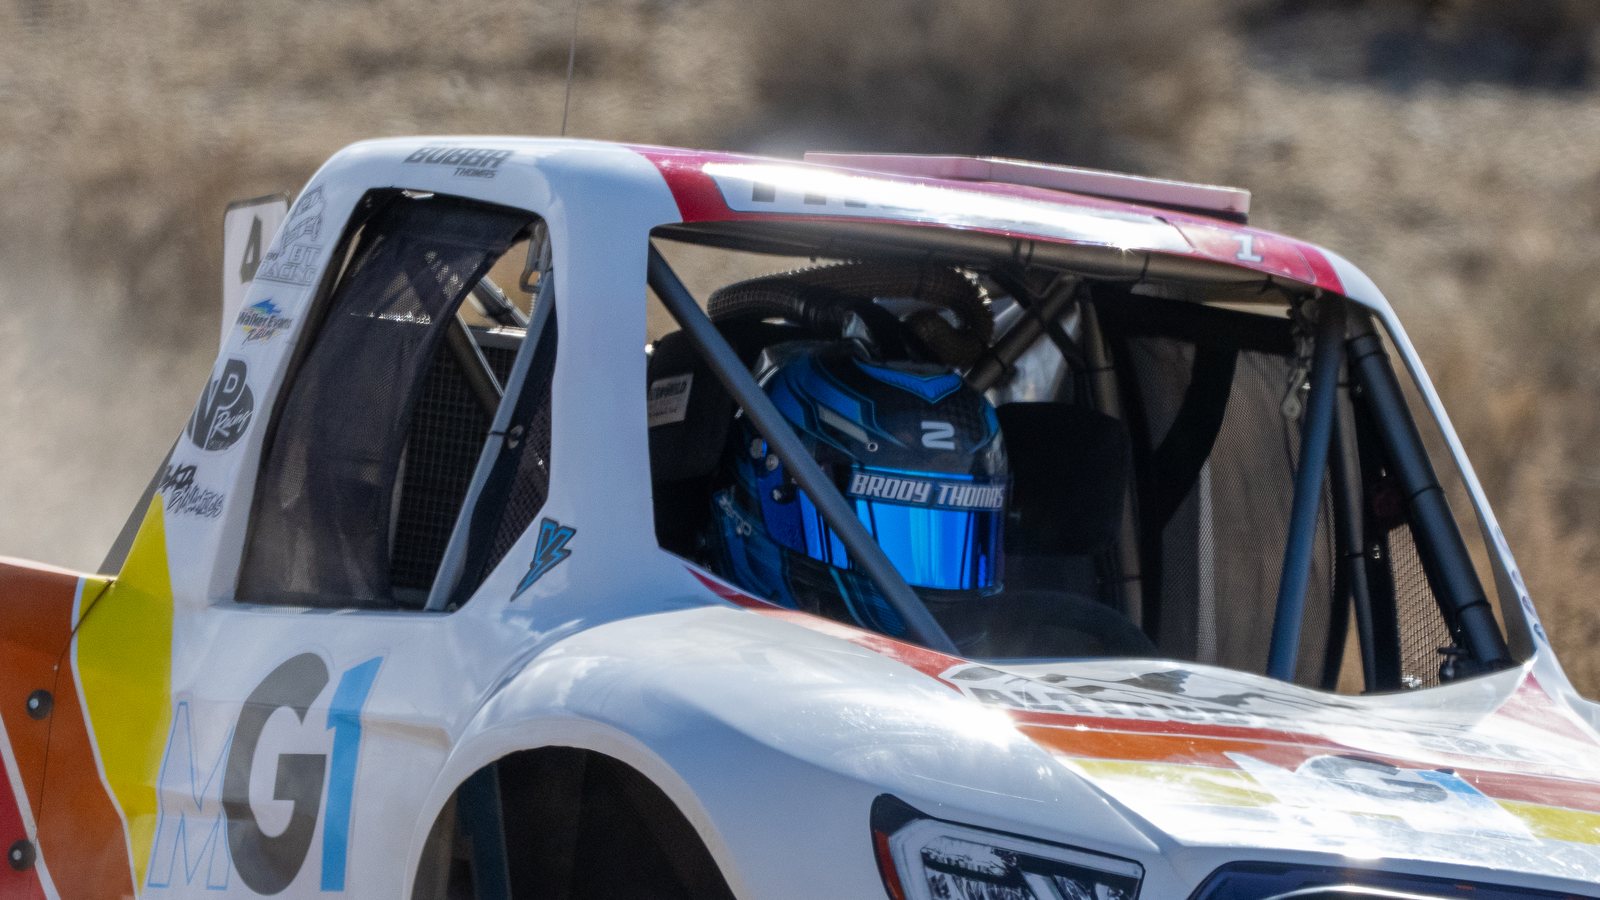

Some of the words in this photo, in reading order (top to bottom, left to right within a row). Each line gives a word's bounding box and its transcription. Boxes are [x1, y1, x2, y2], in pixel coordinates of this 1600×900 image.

[403, 147, 514, 169] BUBBA
[453, 167, 498, 179] THOMAS
[1232, 233, 1263, 262] 1
[236, 310, 267, 326] Walker
[267, 315, 293, 329] Evans
[190, 358, 247, 451] VP
[211, 409, 254, 439] Racing
[920, 420, 956, 450] 2
[850, 473, 931, 503] BRODY
[937, 483, 1005, 509] THOMAS
[147, 652, 384, 896] MG1
